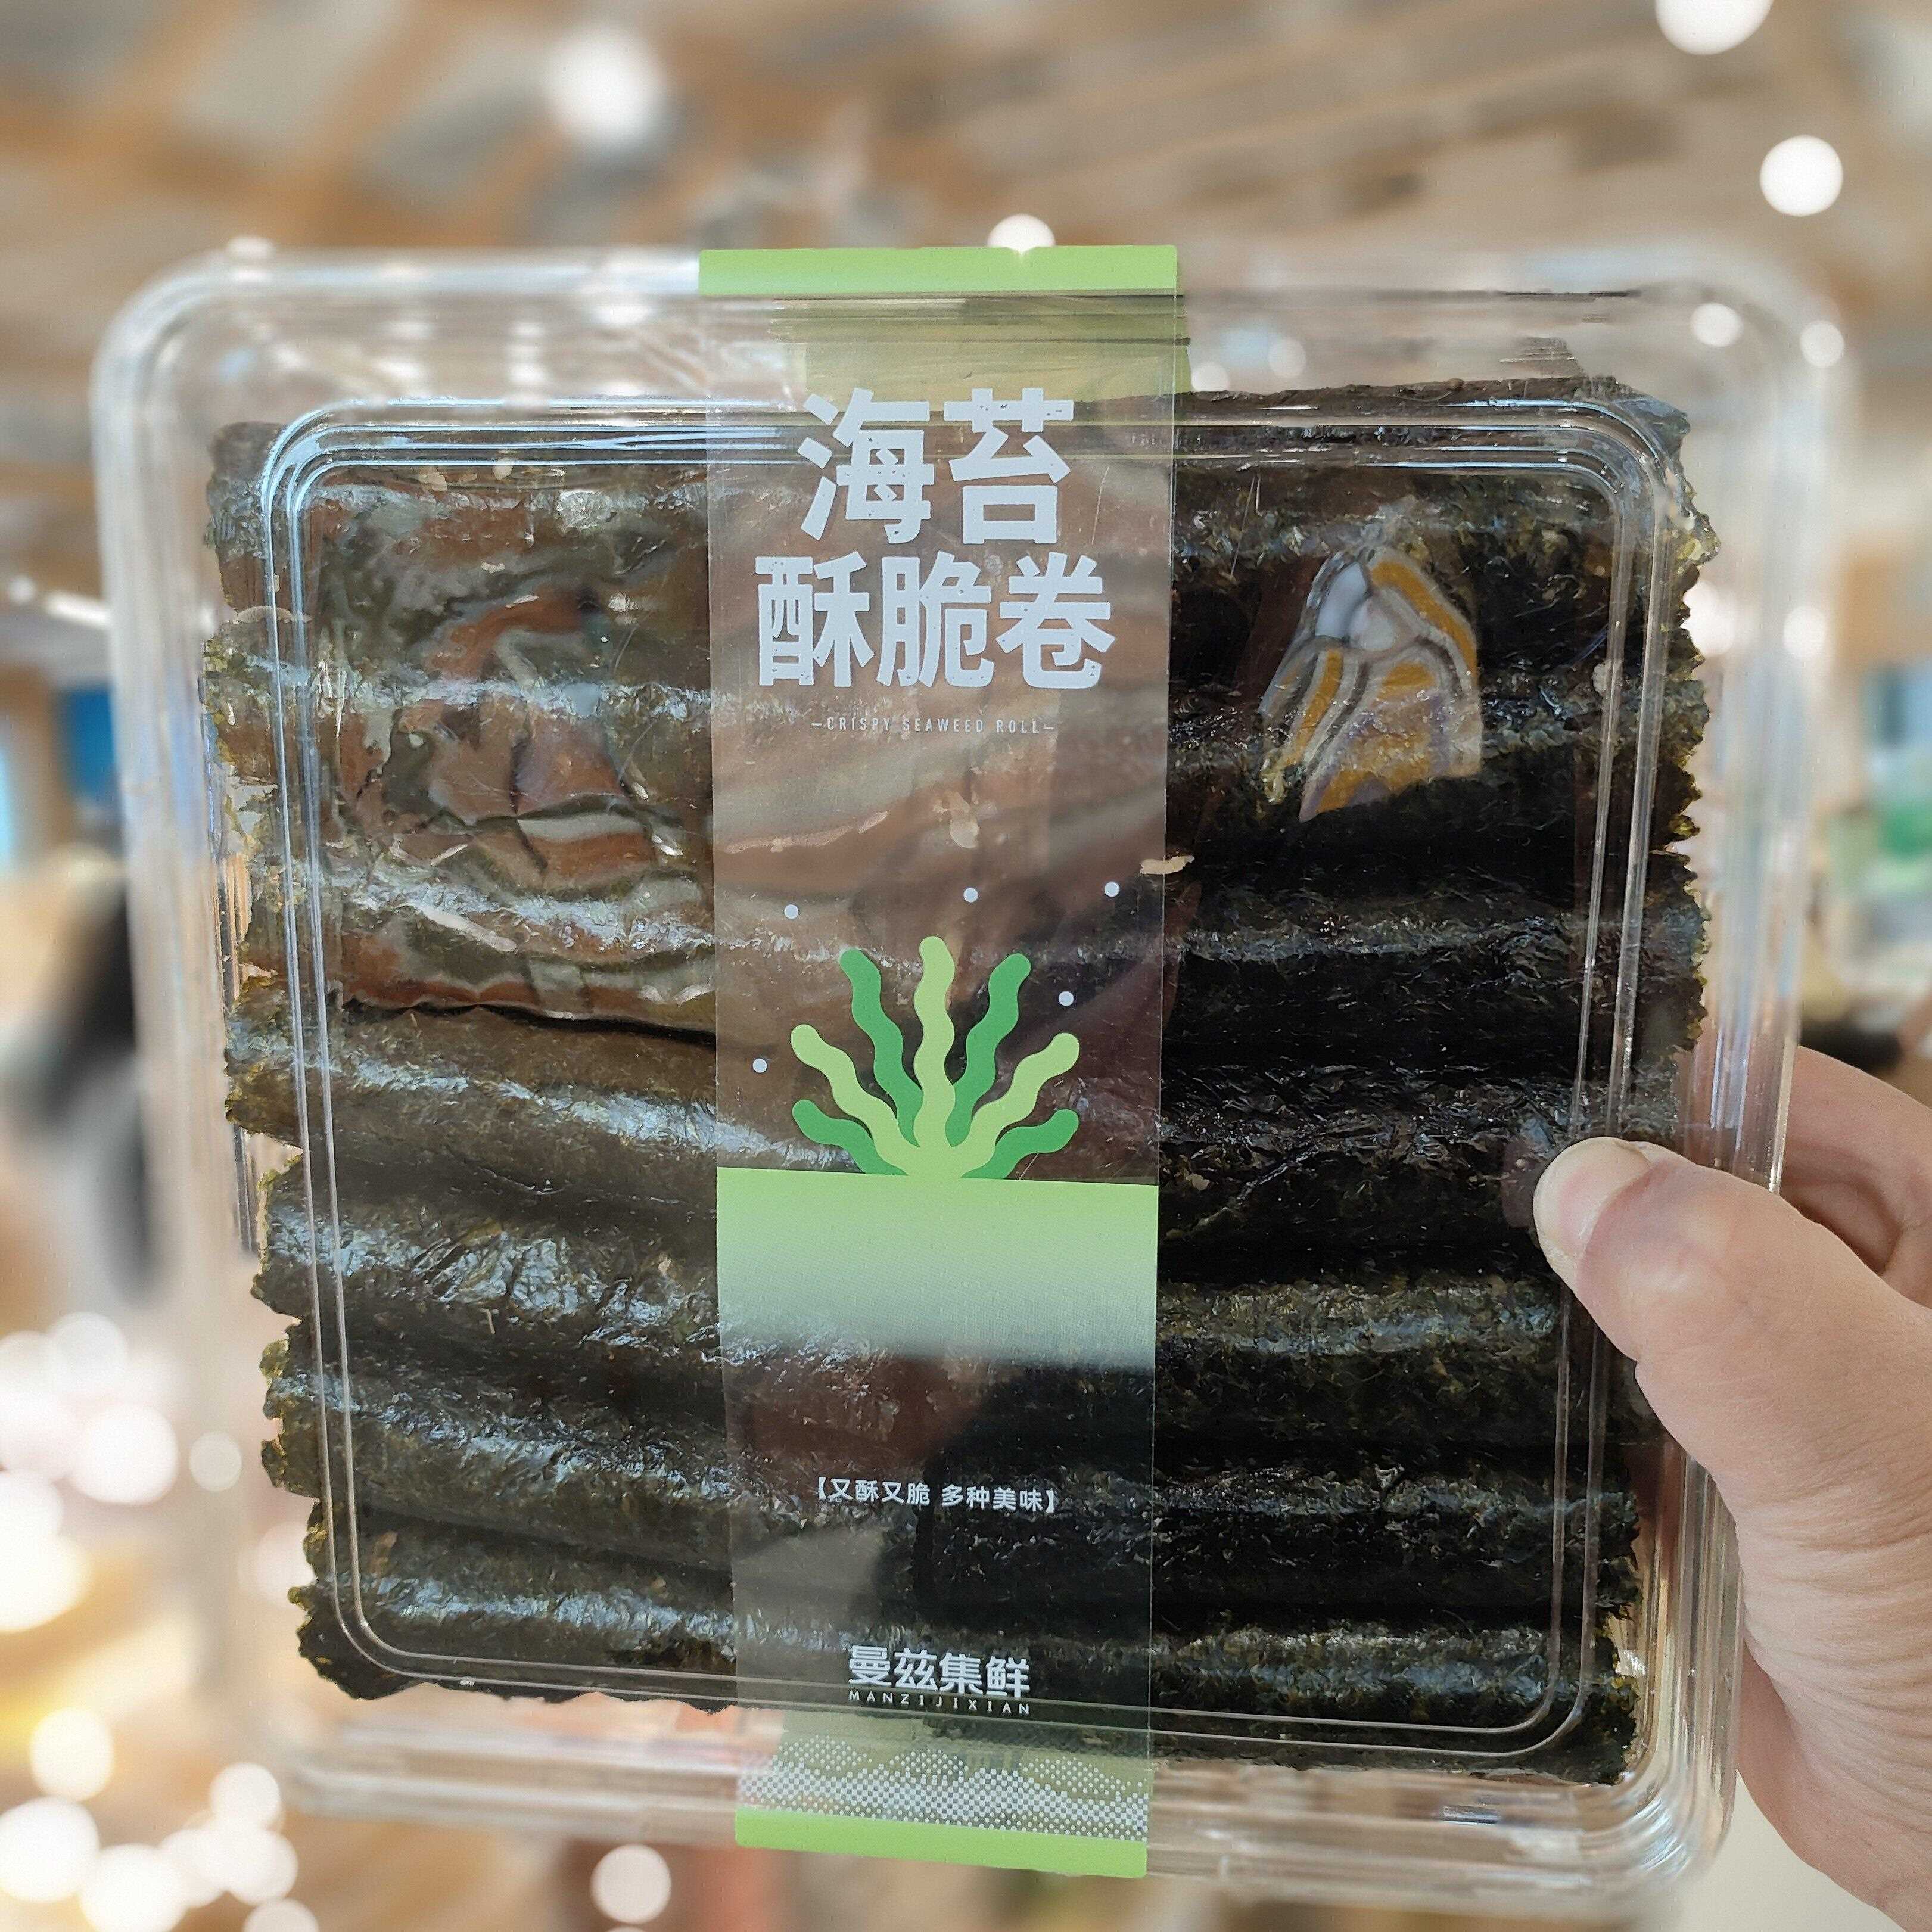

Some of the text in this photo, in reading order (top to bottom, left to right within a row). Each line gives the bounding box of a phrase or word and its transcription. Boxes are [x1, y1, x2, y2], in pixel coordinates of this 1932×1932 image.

[797, 388, 1074, 544] 海苔
[755, 550, 1116, 689] 酥脆卷
[901, 718, 984, 733] SEAWEED
[848, 1645, 1031, 1698] 曼兹集鲜
[848, 1690, 1030, 1716] MANZIJIXIAN
